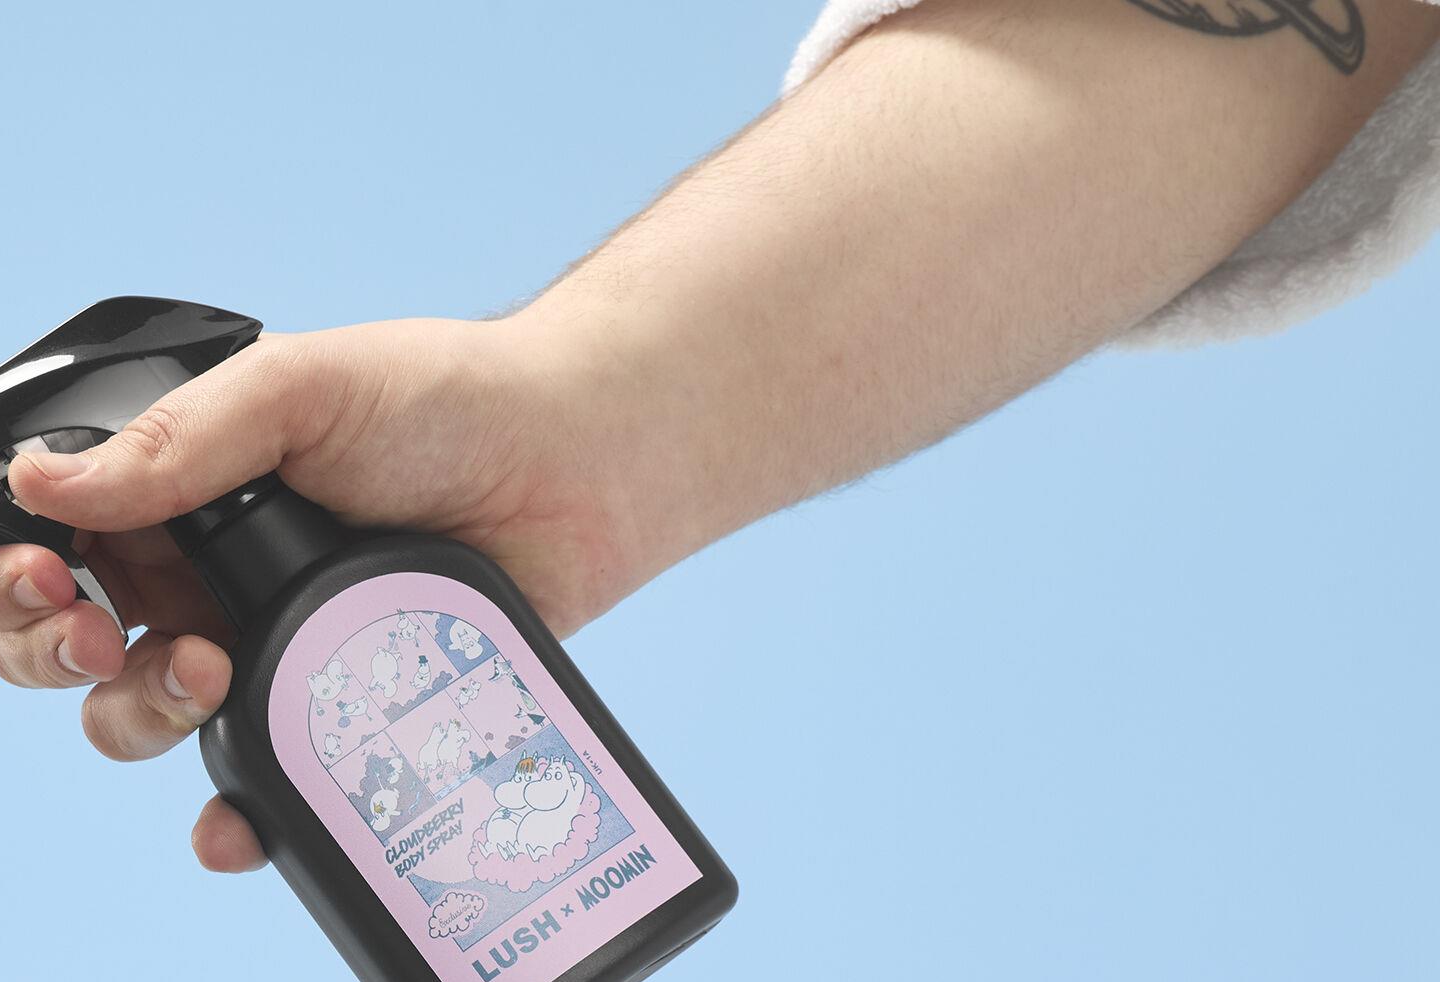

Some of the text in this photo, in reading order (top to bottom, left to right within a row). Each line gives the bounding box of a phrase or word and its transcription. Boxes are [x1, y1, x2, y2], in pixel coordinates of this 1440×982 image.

[385, 797, 464, 864] CLOUDBERRY
[394, 820, 463, 878] BODY SPRAY
[471, 910, 562, 982] LUSH
[575, 843, 657, 911] MOOMIN
